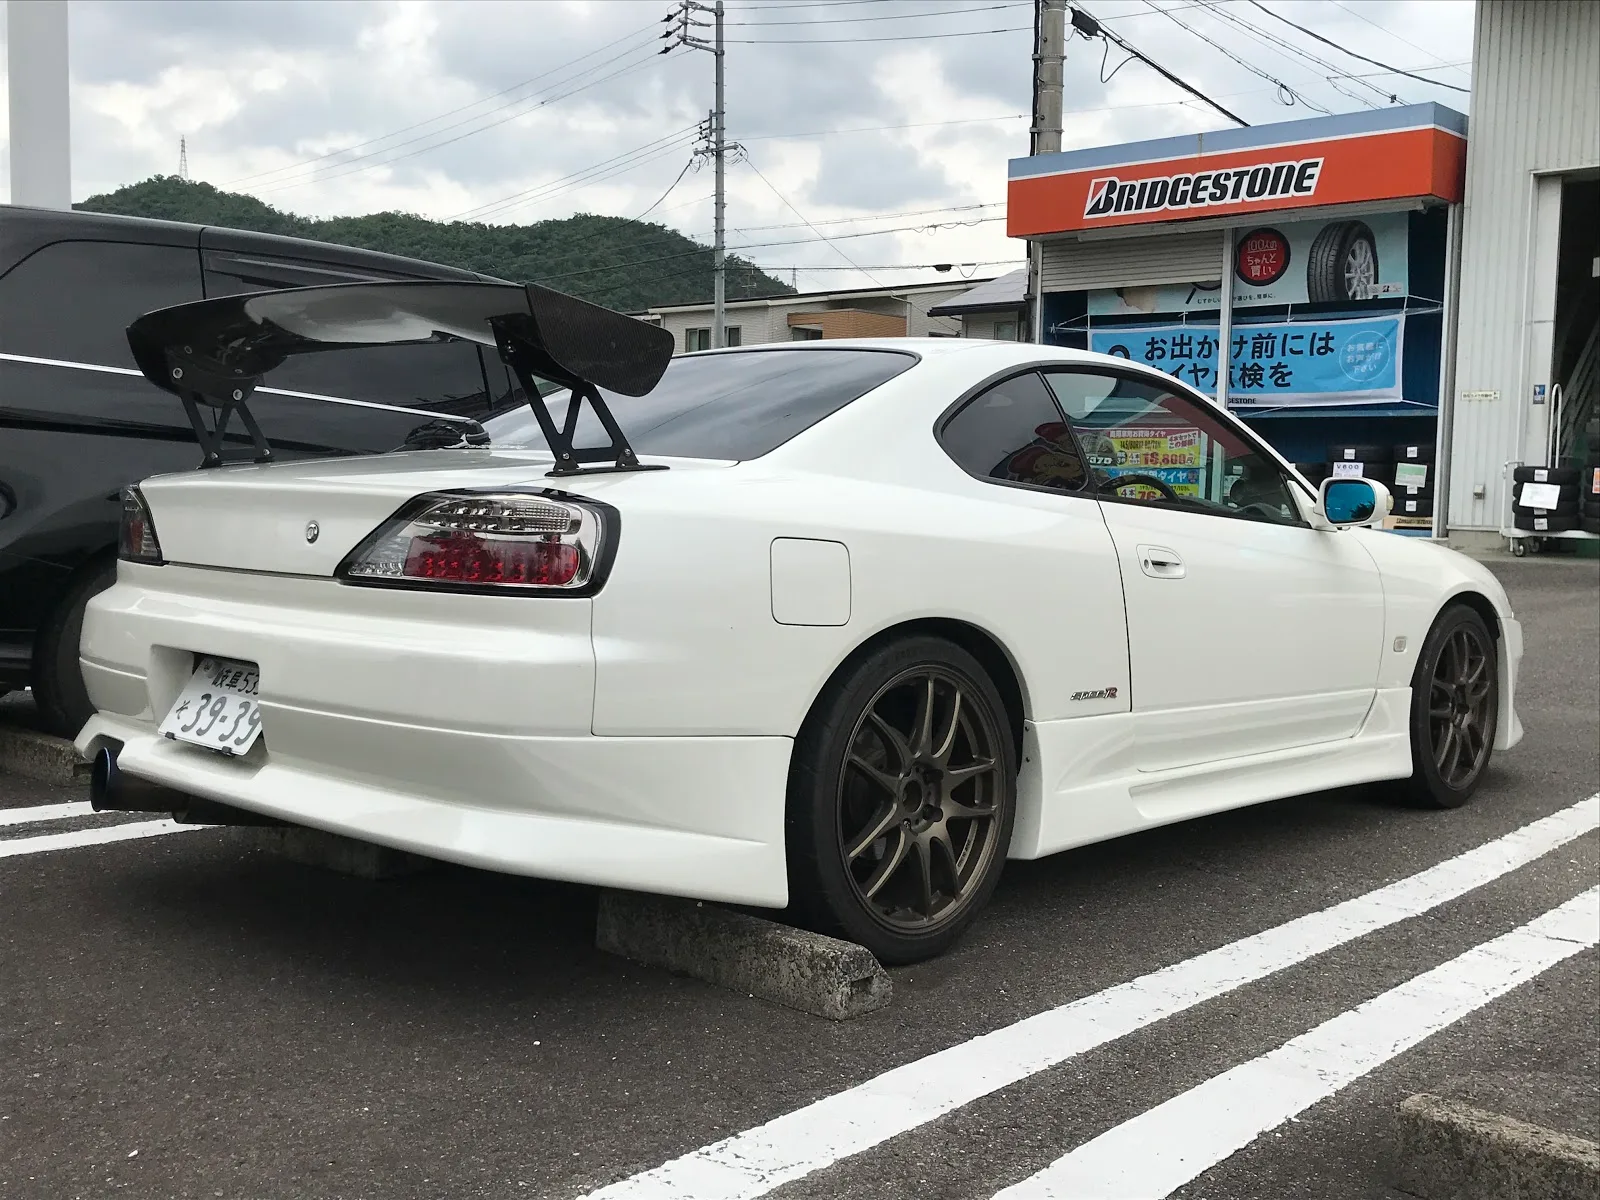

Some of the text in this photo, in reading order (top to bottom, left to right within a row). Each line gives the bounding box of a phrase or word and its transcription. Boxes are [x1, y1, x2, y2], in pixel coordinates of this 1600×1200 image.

[1085, 161, 1320, 216] BRIDGESTONE
[1247, 253, 1277, 266] ちゃんと
[1144, 331, 1335, 361] お出かけ前には
[180, 693, 261, 746] 39-39
